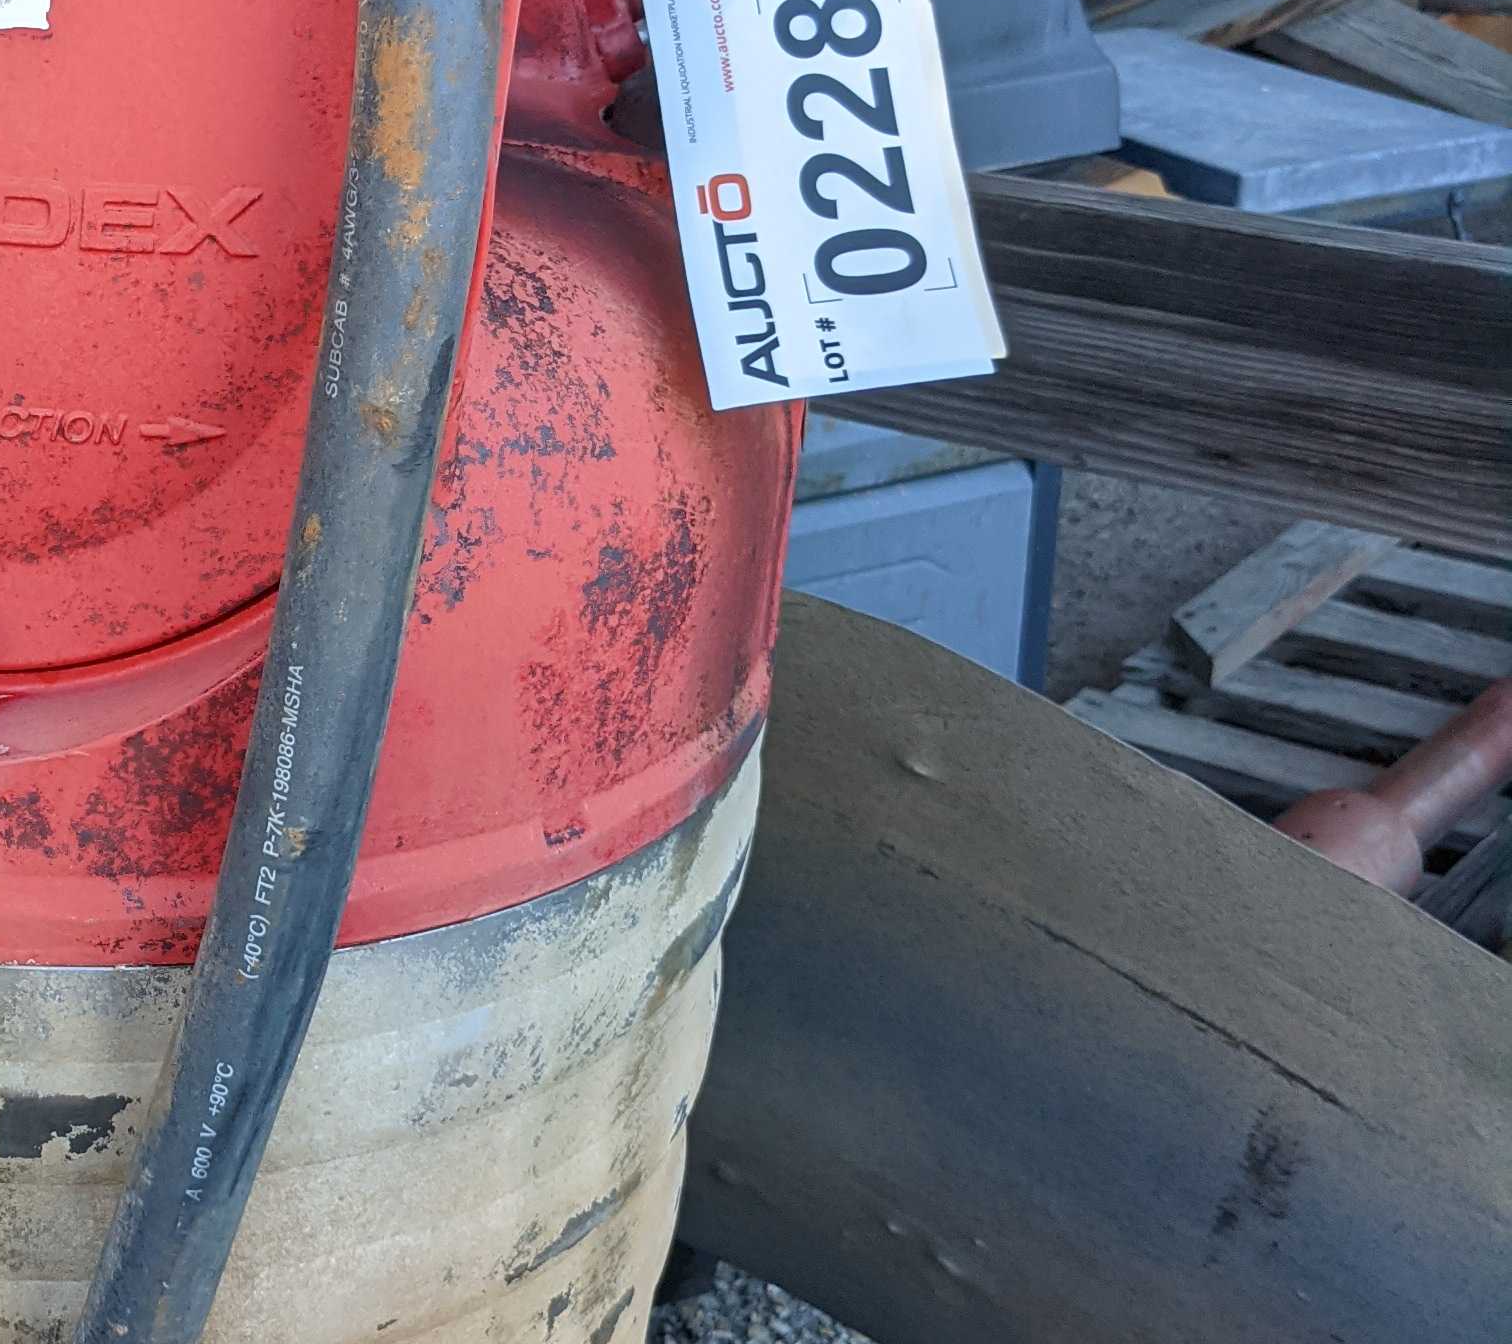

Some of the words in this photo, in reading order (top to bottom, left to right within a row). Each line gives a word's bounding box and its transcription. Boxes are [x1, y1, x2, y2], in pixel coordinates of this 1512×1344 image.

[675, 42, 690, 95] LIQUIDATION
[682, 98, 697, 144] INDUSTRIAL
[815, 316, 837, 332] #
[324, 299, 349, 399] SUBCAB
[819, 338, 850, 383] LOT
[262, 664, 305, 858] P-7K-198086-MSHA
[255, 864, 277, 906] FT2
[199, 1122, 217, 1138] V
[191, 1146, 213, 1180] 600
